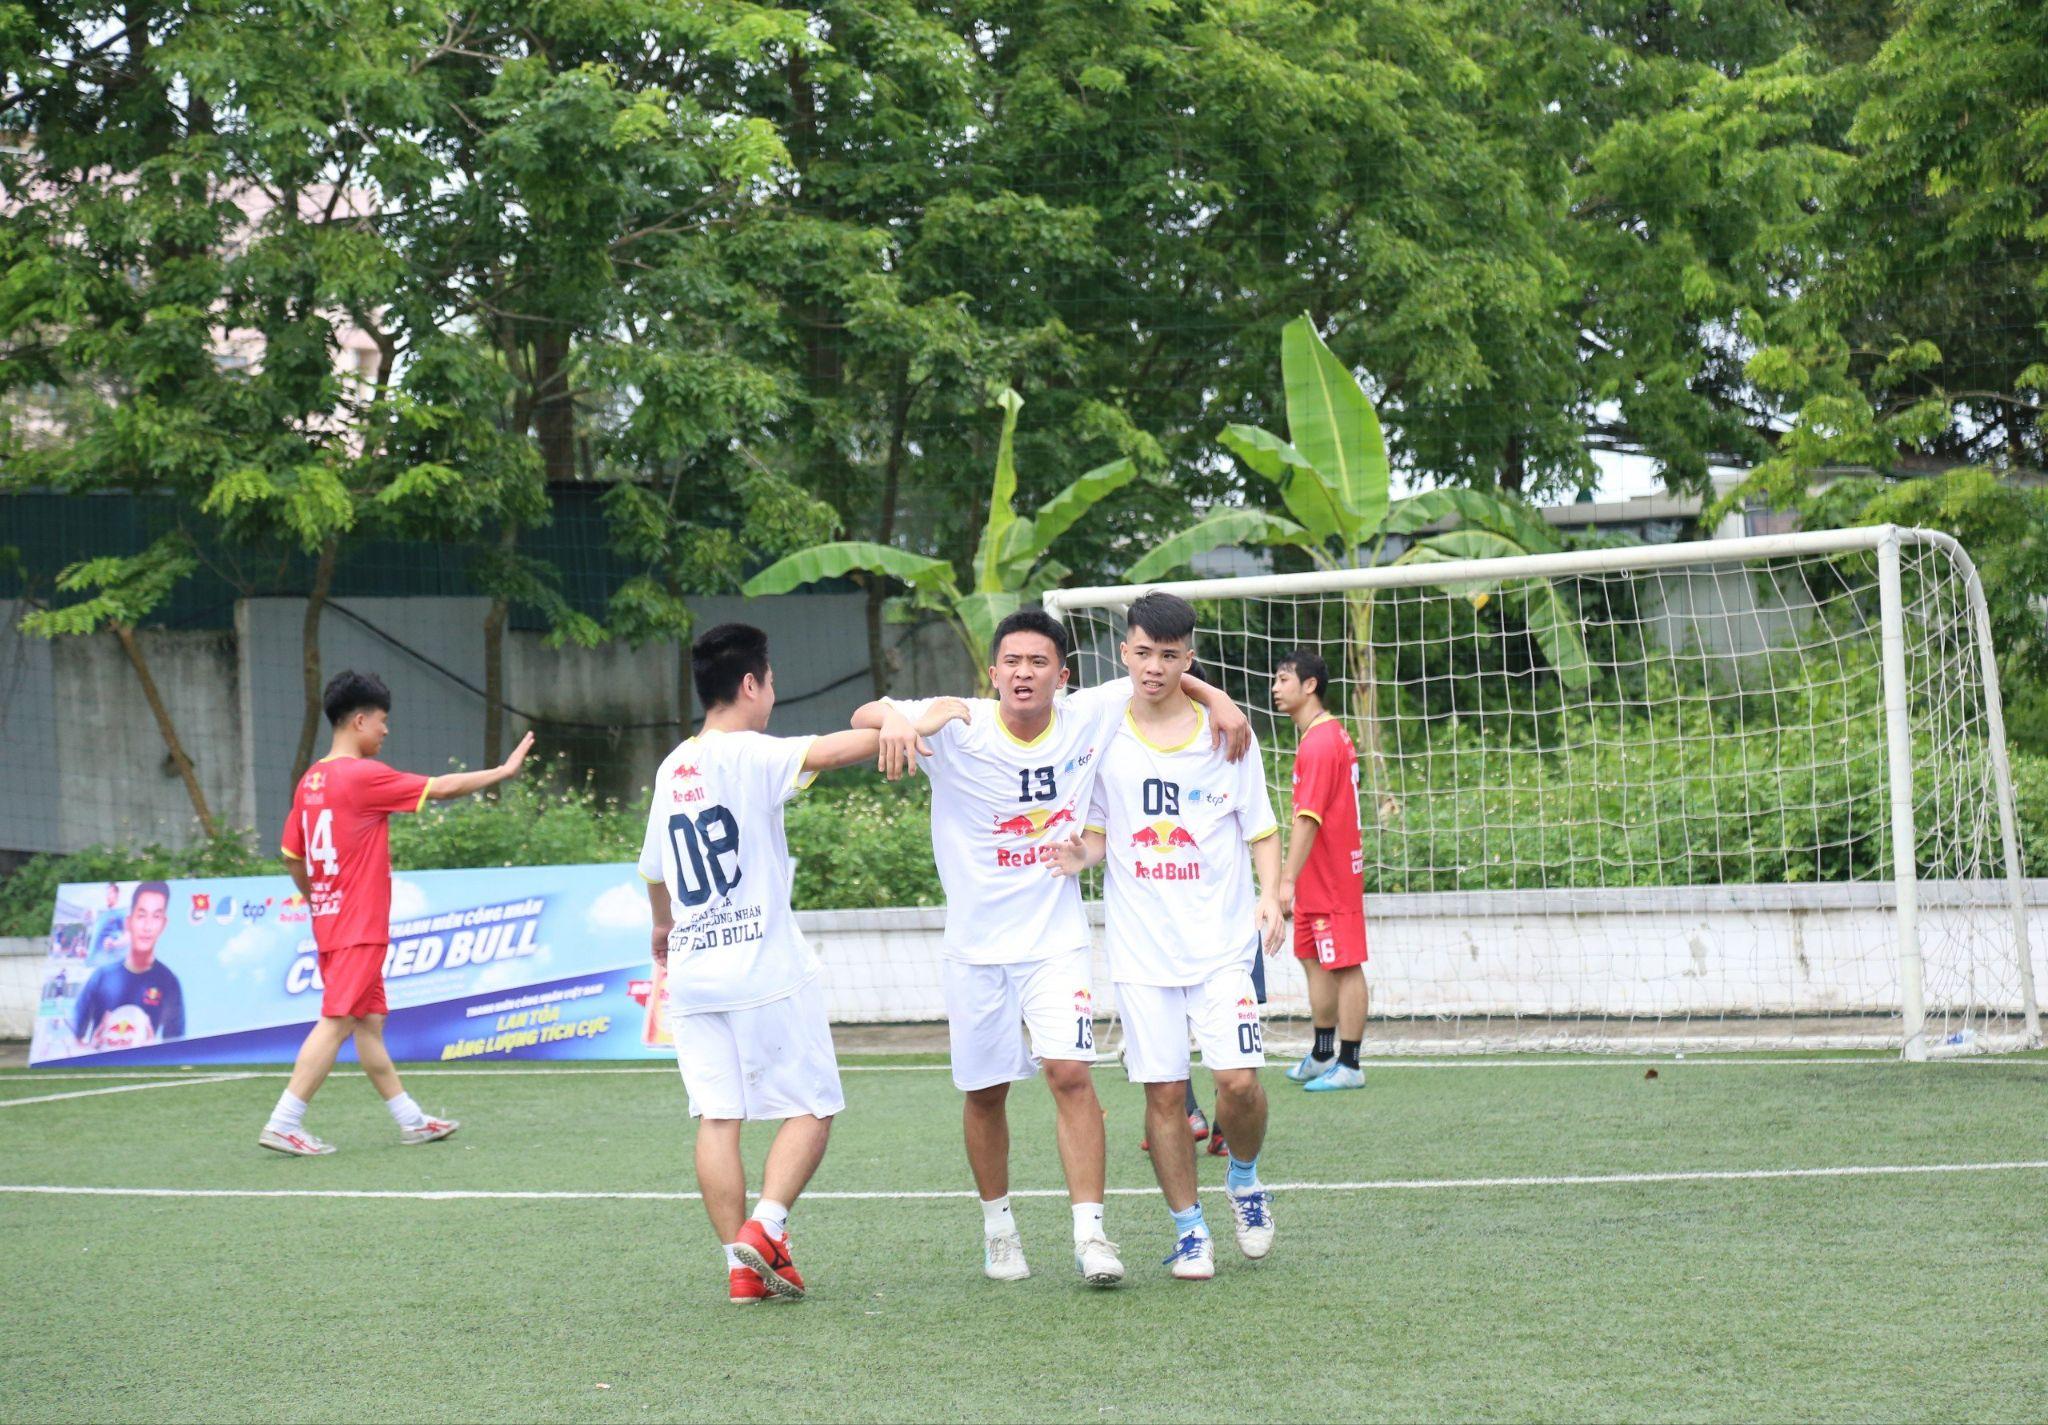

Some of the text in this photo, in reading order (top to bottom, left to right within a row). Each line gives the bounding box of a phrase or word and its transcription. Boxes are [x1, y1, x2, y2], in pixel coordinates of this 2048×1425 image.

[1019, 765, 1057, 802] 13
[1143, 778, 1180, 815] 09
[302, 808, 339, 877] 14
[997, 846, 1037, 867] Red
[1165, 862, 1200, 880] Bull
[464, 906, 503, 927] CÔNG
[443, 919, 537, 969] BULL
[722, 921, 763, 946] BULL
[1076, 1016, 1093, 1049] 13
[1238, 1022, 1262, 1053] 09
